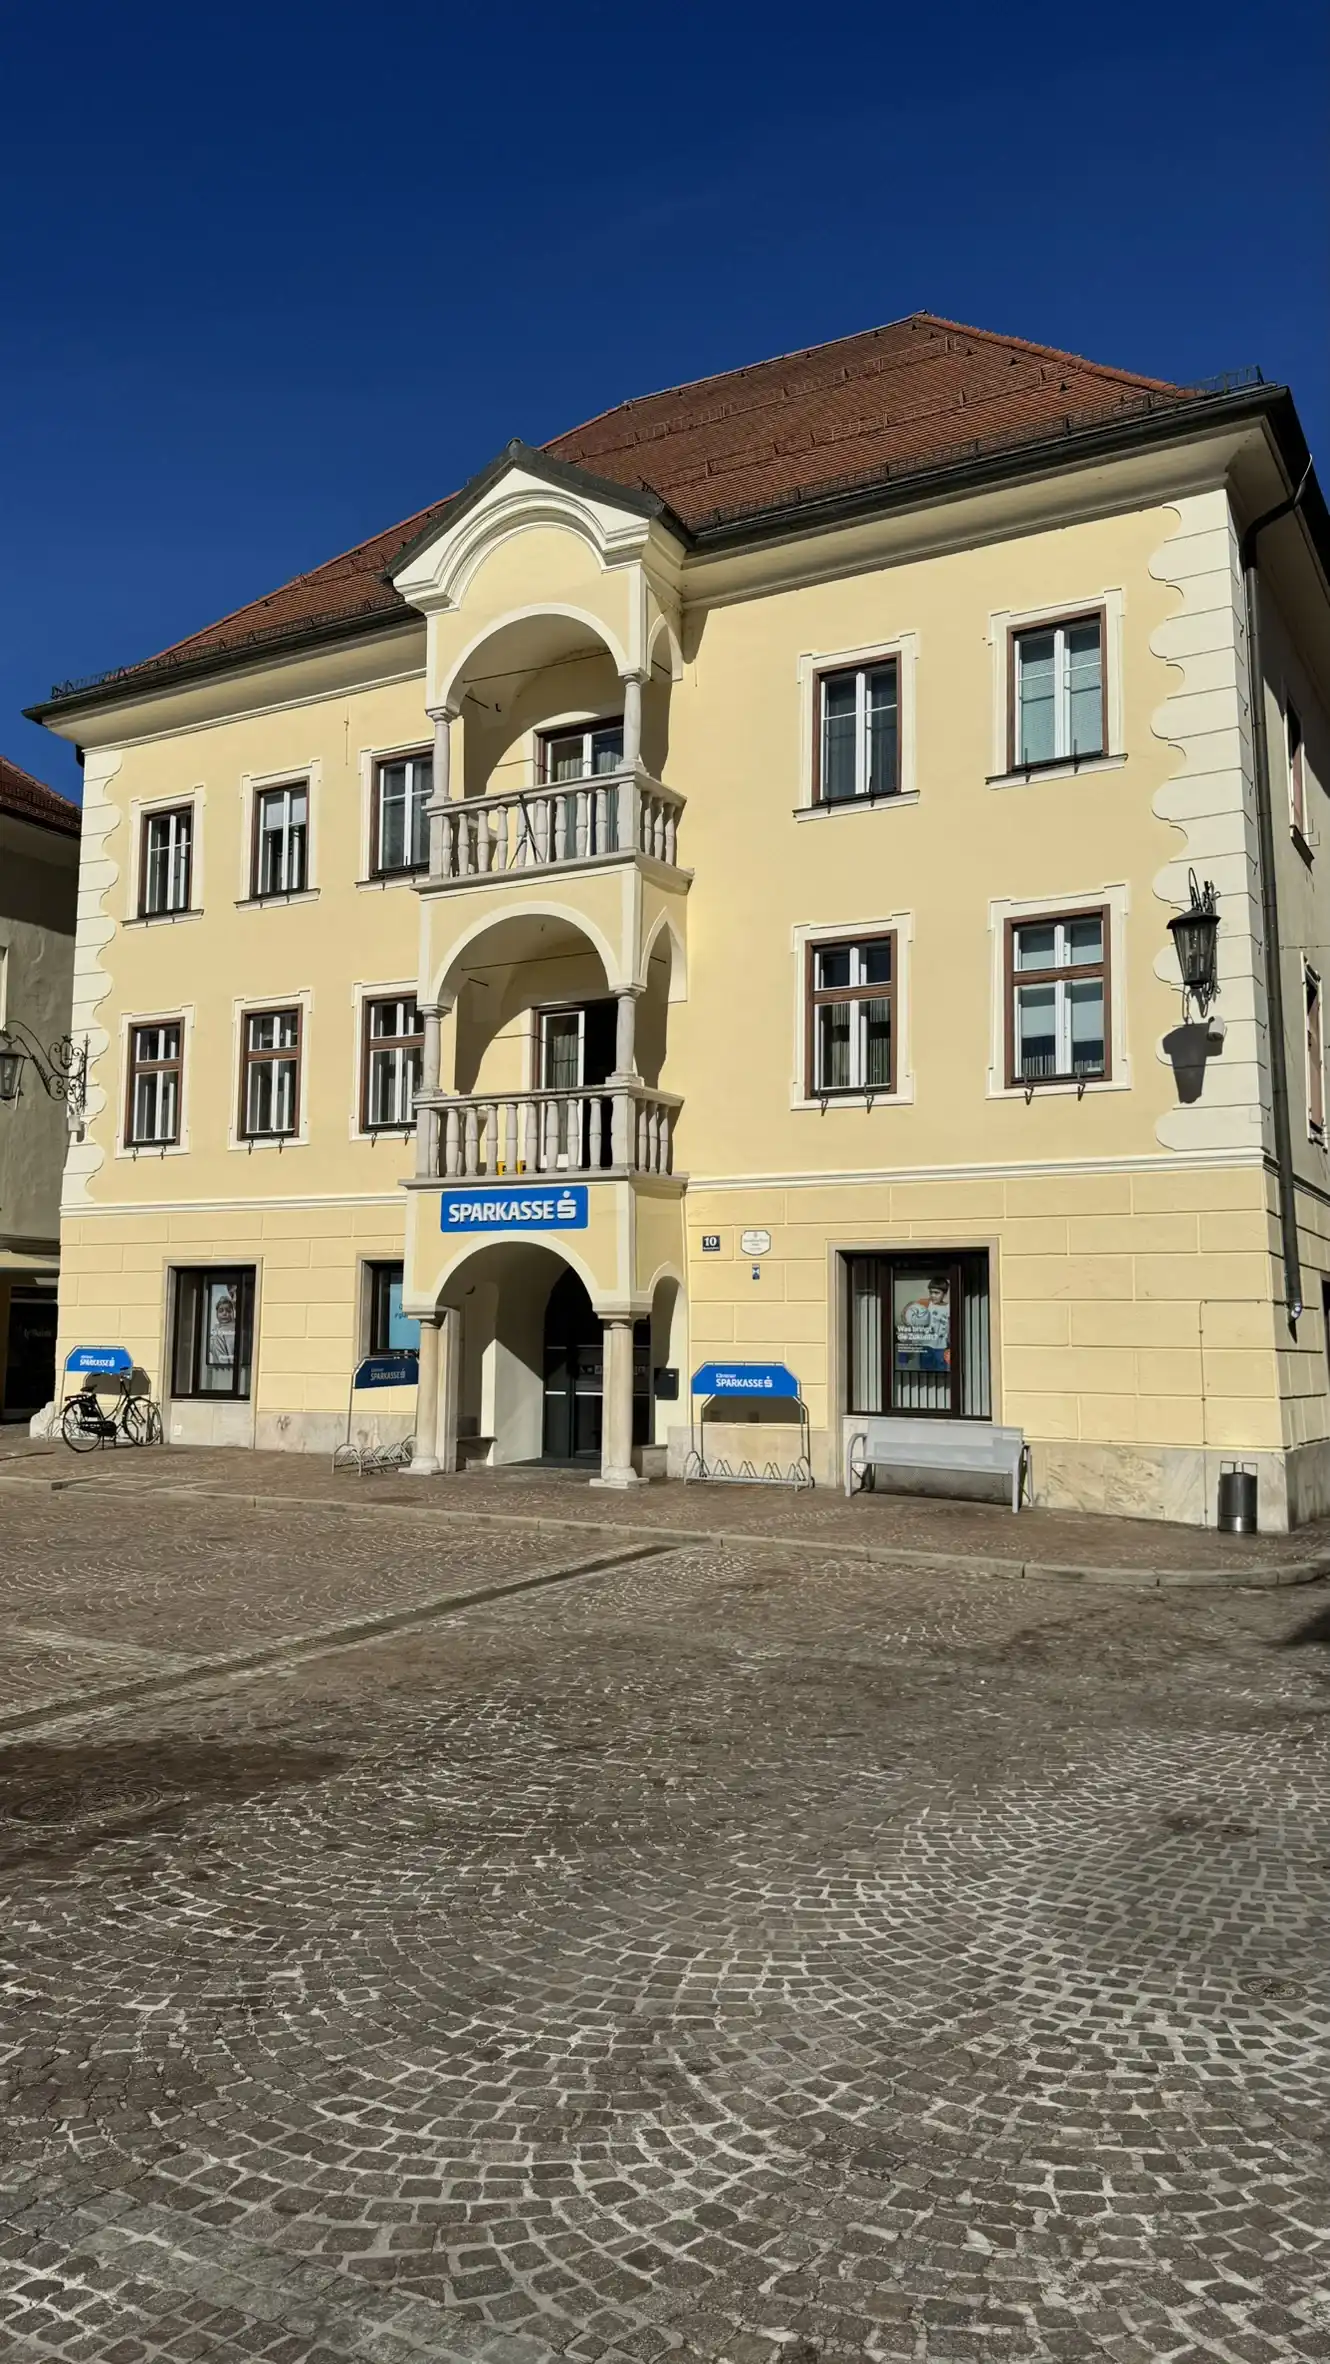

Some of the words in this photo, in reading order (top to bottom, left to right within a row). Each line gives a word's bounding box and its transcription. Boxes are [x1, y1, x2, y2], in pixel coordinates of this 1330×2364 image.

[448, 1200, 555, 1223] SPARKASSE
[704, 1237, 717, 1247] 10
[715, 1378, 764, 1388] SPARKASSE
